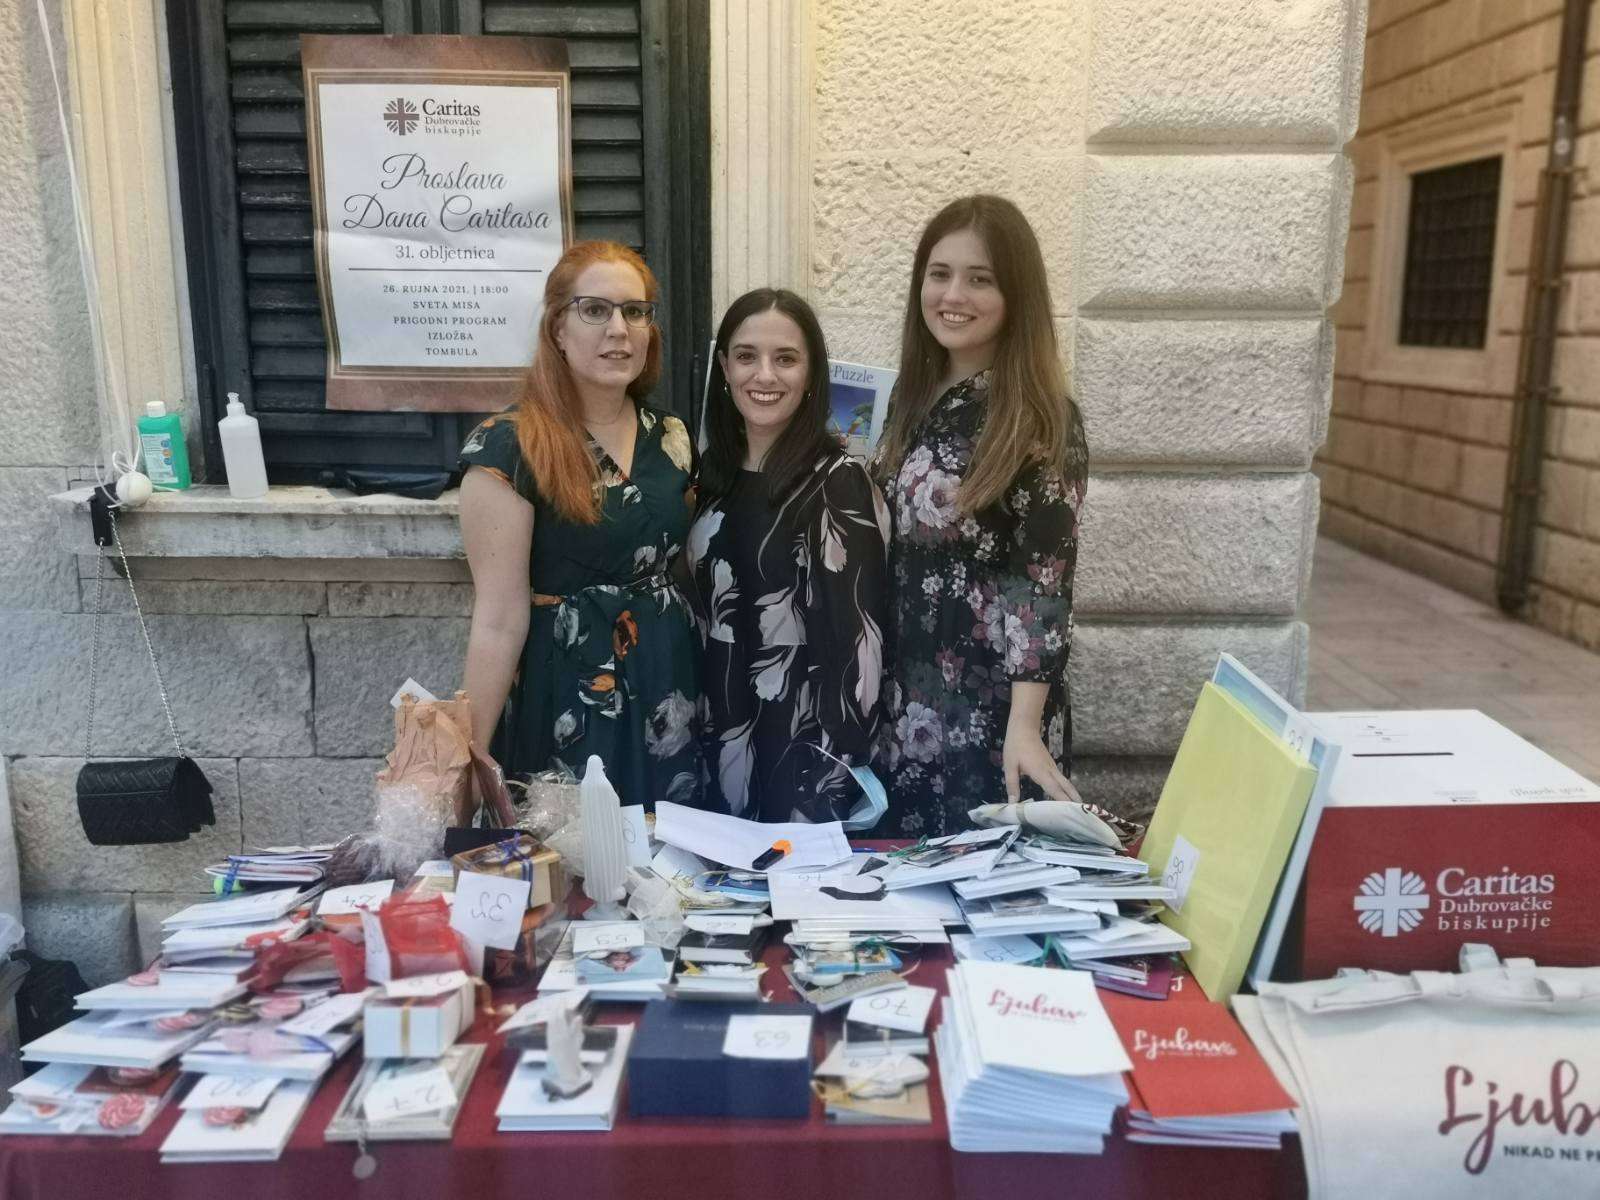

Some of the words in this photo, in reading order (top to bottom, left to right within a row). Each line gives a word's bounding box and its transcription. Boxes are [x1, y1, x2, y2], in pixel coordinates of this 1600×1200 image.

[422, 98, 481, 117] Caritas
[424, 116, 481, 126] Dubrovačke
[425, 125, 482, 136] biskupije
[381, 153, 507, 190] Proslava
[342, 193, 429, 229] Dana
[440, 192, 552, 232] Caritasa
[395, 245, 415, 259] 31.
[419, 245, 496, 263] obljetnica
[402, 285, 439, 294] RUJNA
[480, 285, 509, 294] 18:00
[412, 301, 448, 309] SVETA
[452, 301, 480, 309] MISA
[393, 316, 448, 325] PRIGODNI
[452, 316, 507, 325] PROGRAM
[428, 329, 474, 340] IZLOŽBA
[425, 347, 478, 356] TOMBULA
[833, 365, 874, 383] Puzzle
[1436, 866, 1555, 897] Caritas
[1439, 896, 1553, 914] Dubrovačke
[1438, 913, 1551, 933] biskupije
[1438, 1058, 1600, 1176] Ljub
[1503, 1145, 1554, 1160] NIKAD
[1559, 1148, 1581, 1161] NE
